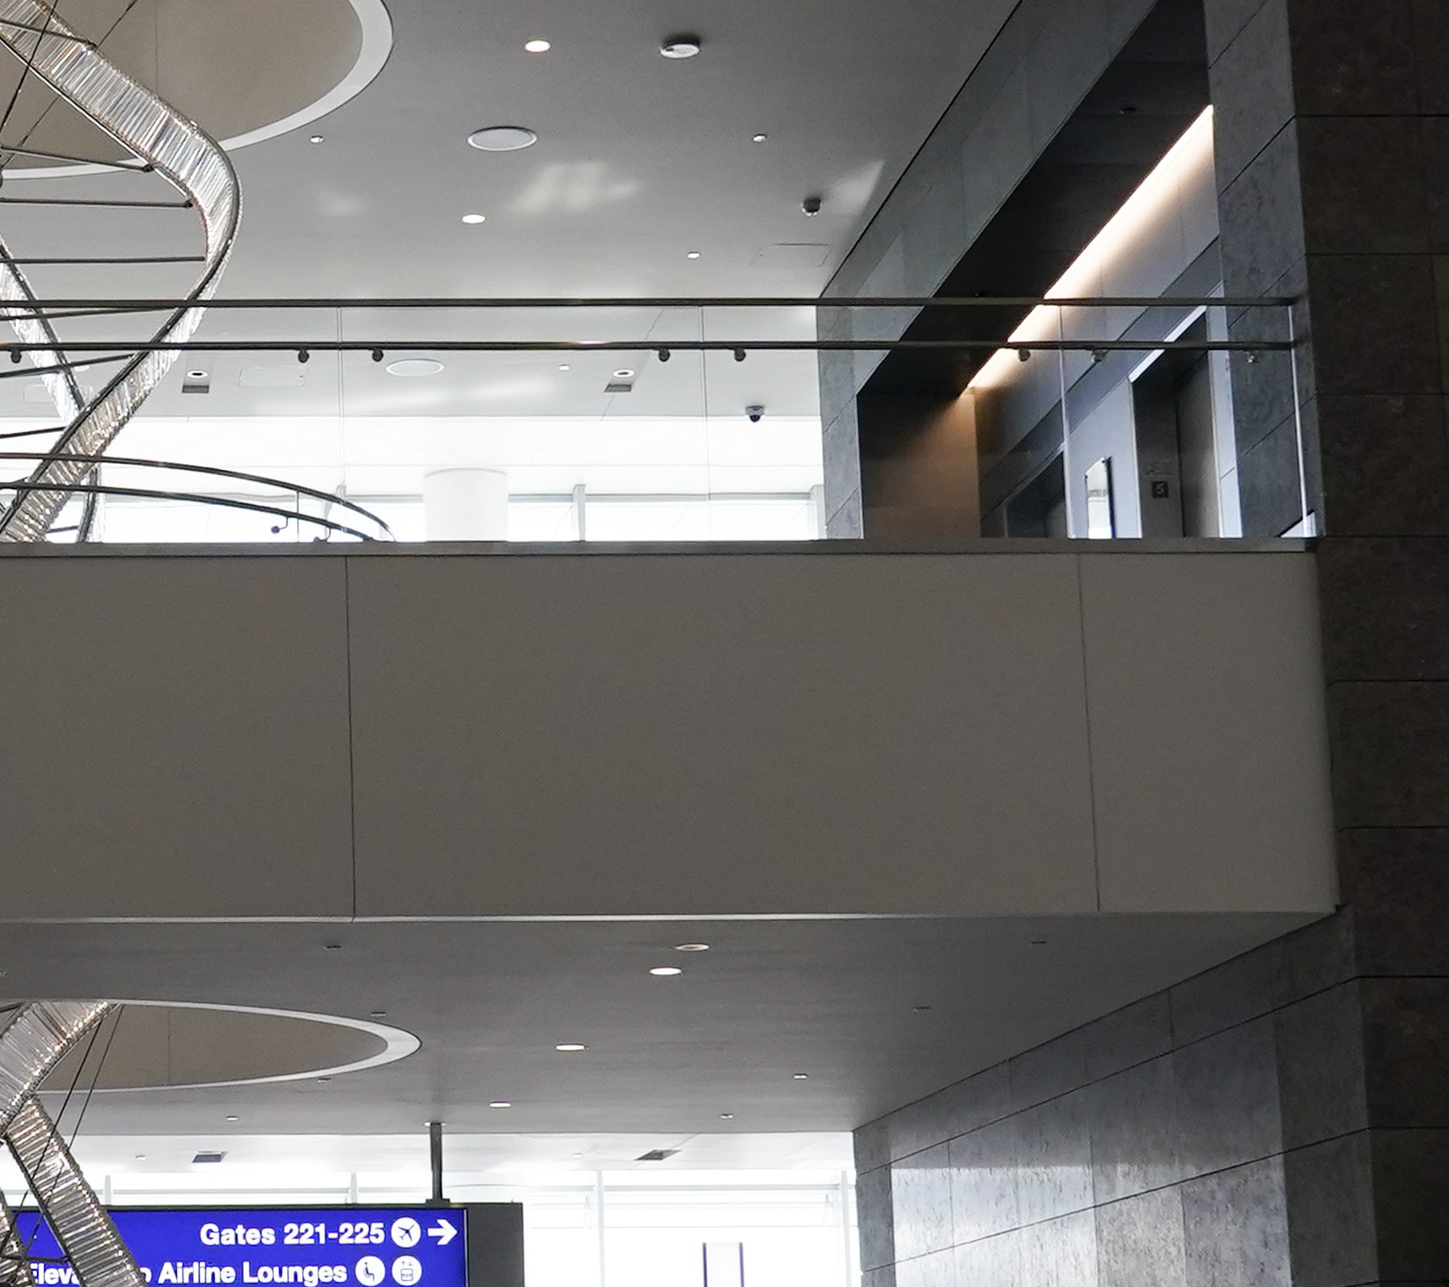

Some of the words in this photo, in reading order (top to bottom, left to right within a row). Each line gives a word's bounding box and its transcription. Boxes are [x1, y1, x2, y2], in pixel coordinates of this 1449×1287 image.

[200, 1222, 275, 1246] Gates
[284, 1222, 385, 1246] 221-225
[30, 1262, 80, 1285] Elev
[158, 1260, 235, 1284] Airline
[243, 1260, 347, 1287] Lounges
